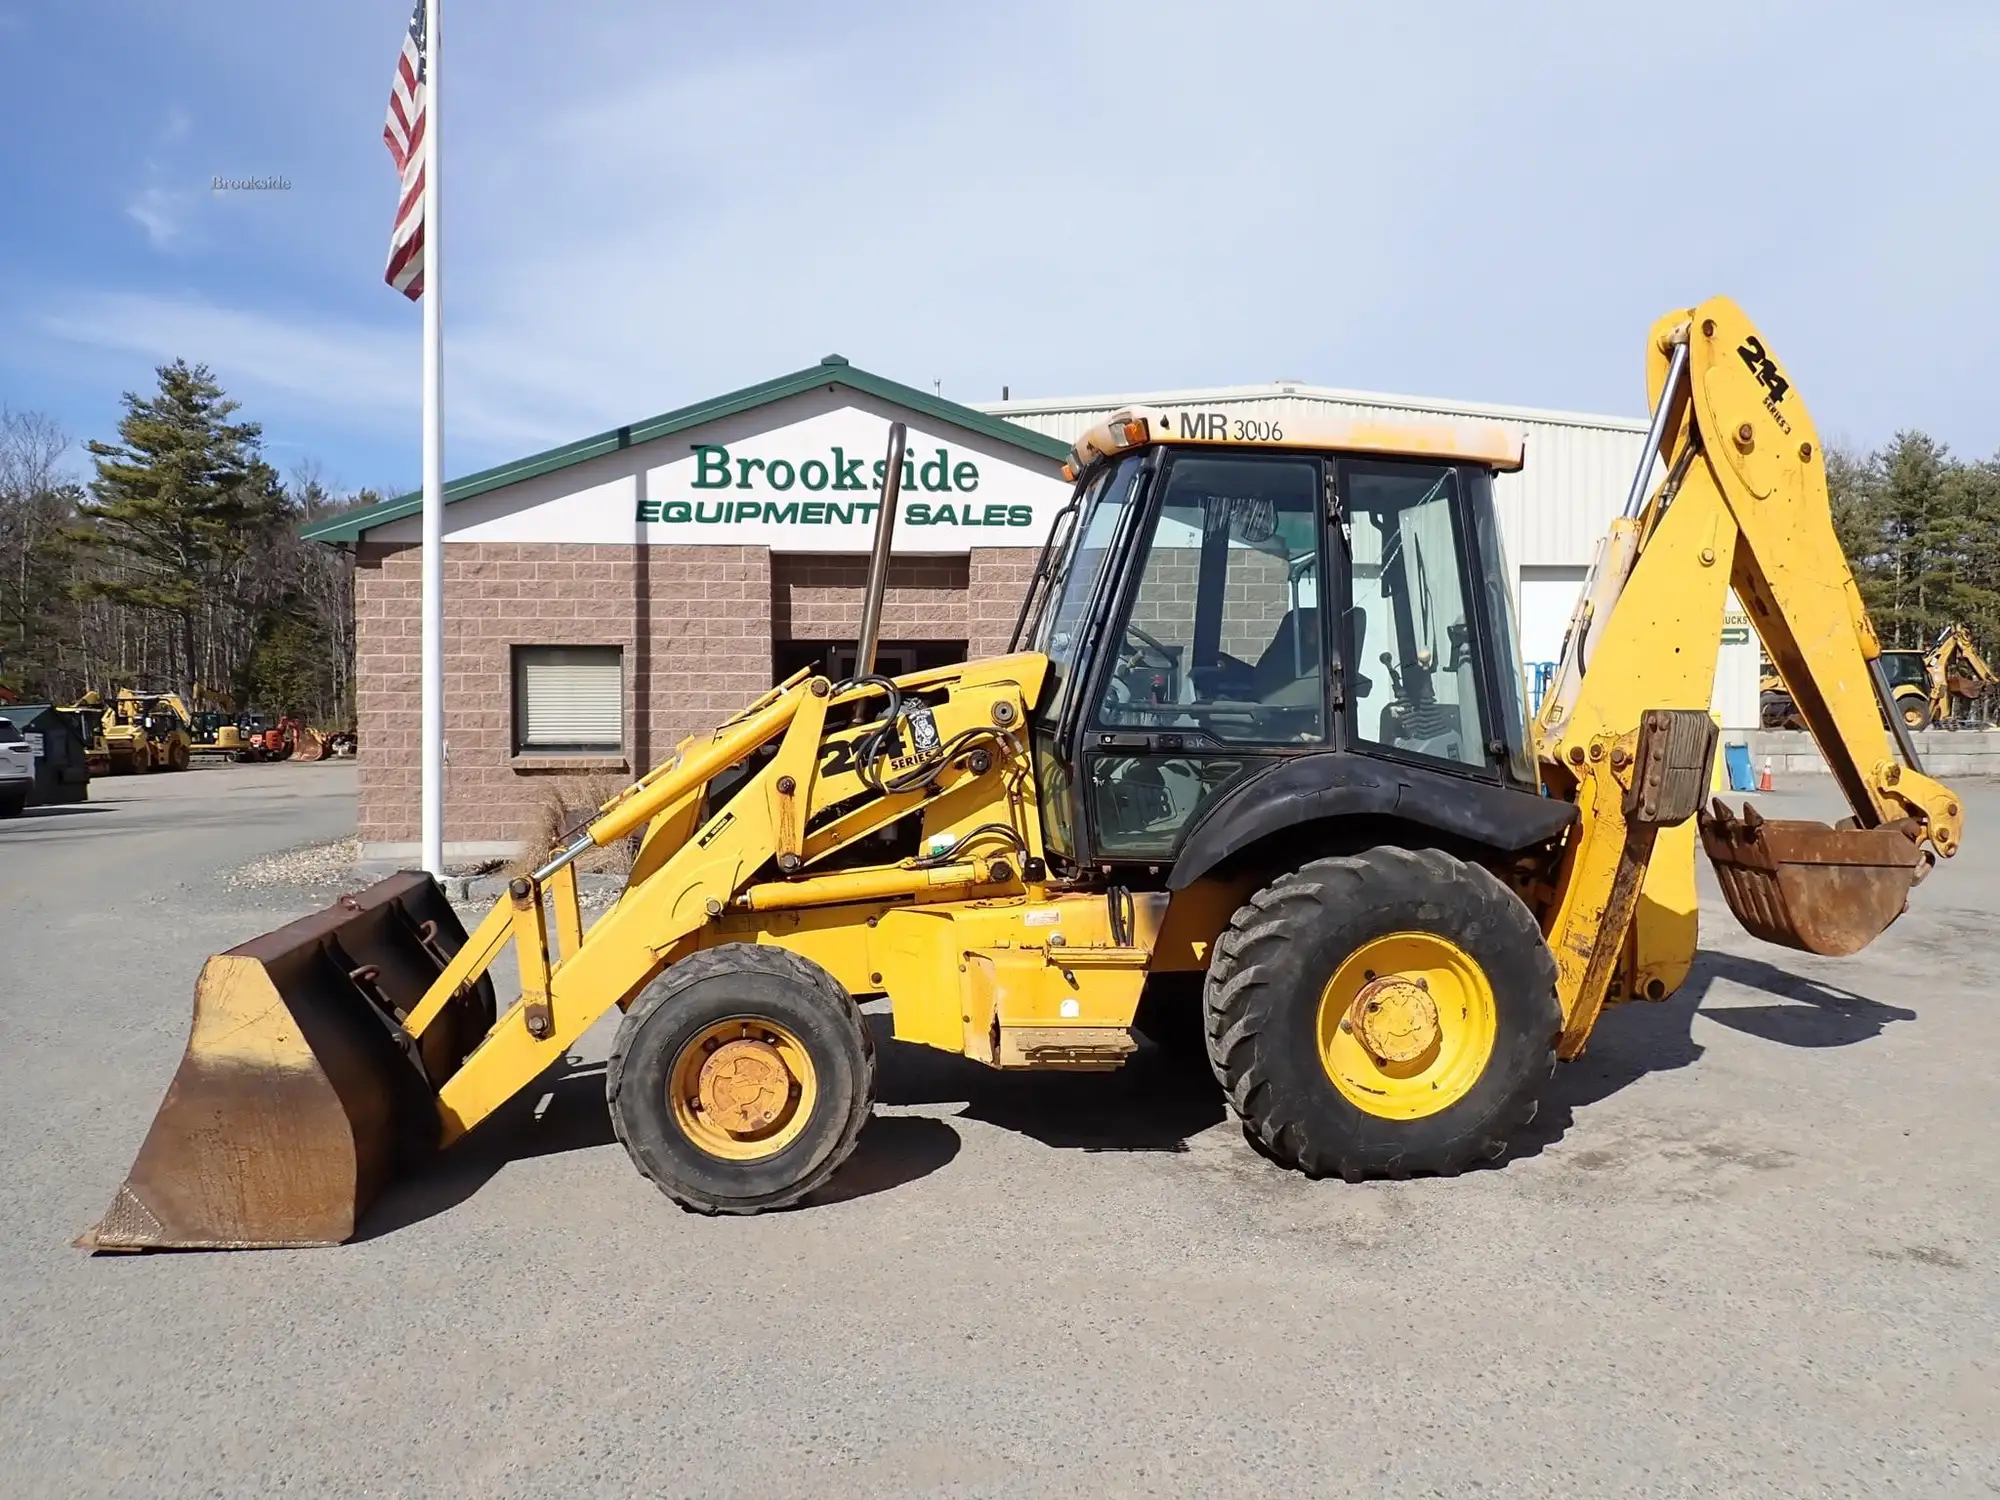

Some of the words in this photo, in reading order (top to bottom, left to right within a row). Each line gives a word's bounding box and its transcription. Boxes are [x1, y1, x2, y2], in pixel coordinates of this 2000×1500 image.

[1762, 396, 1786, 428] SERIES
[1180, 412, 1227, 441] MR
[1233, 420, 1283, 441] 3006
[635, 500, 881, 525] EQUIPMENT
[904, 503, 1033, 527] SALES
[1722, 616, 1748, 625] UCKS
[890, 751, 932, 771] SERIES
